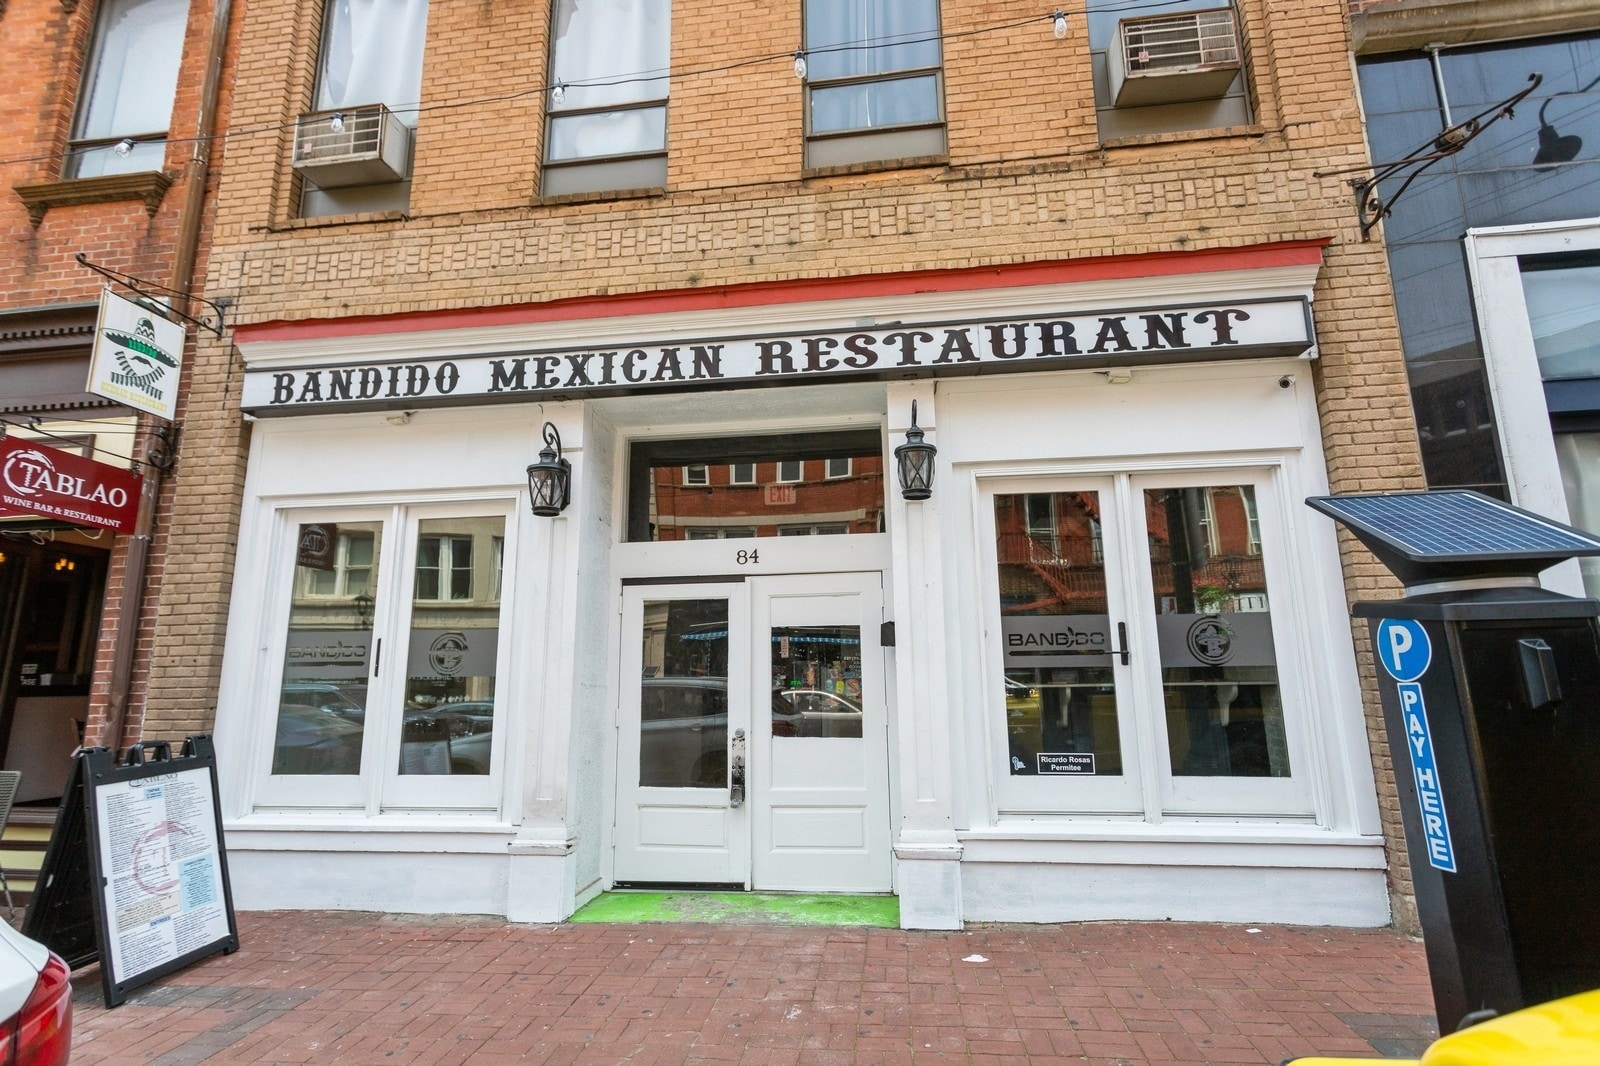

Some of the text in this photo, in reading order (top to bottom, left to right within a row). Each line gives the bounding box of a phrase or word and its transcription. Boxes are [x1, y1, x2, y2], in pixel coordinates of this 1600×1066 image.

[269, 309, 1250, 405] BANDIDO MEXICAN RESTAURANT
[19, 461, 128, 508] TABLAO
[769, 486, 791, 503] EXIT
[3, 495, 122, 528] WINE BAR & RESTAURANT
[736, 548, 760, 565] 84
[1388, 625, 1413, 671] P
[1068, 756, 1091, 764] Rosas
[1403, 690, 1449, 862] PAY HERE
